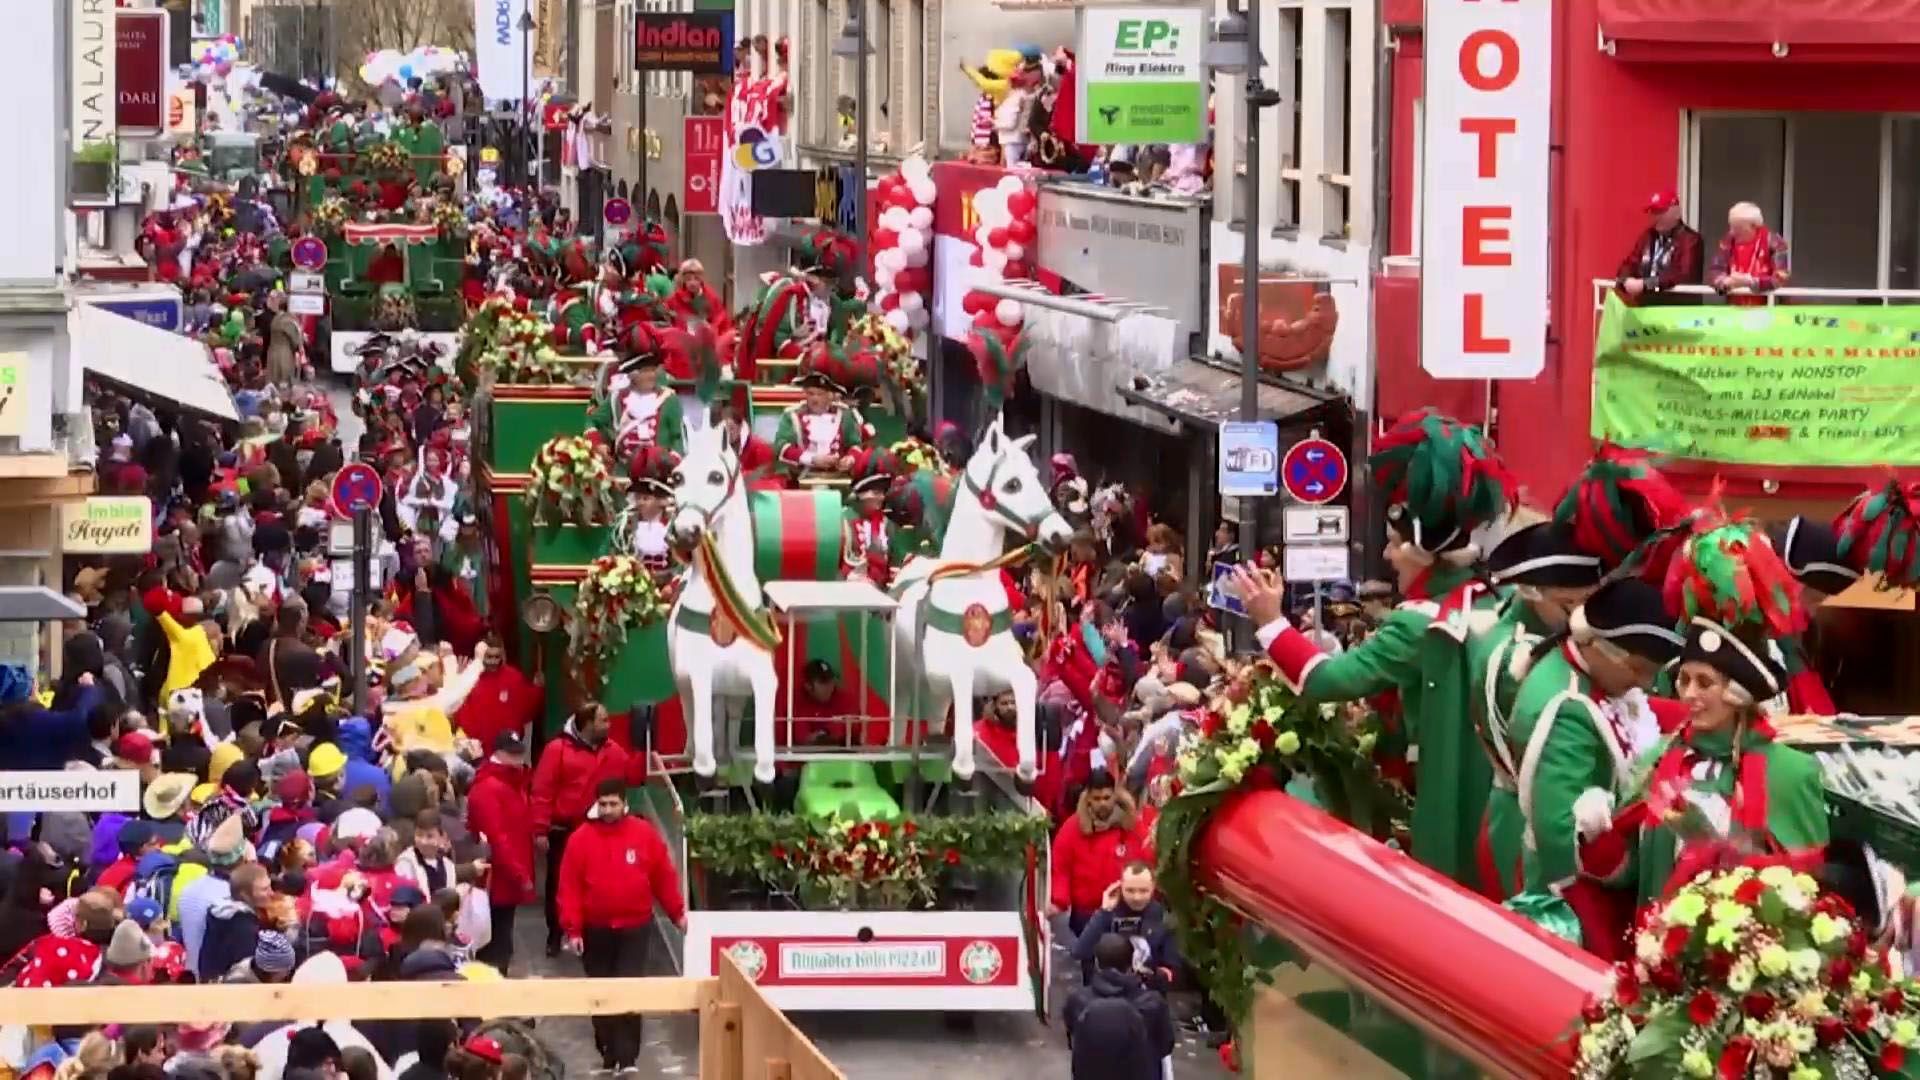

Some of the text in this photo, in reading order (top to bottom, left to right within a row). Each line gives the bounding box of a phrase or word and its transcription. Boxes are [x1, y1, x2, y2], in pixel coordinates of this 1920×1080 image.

[1114, 19, 1180, 50] EP:
[1459, 0, 1519, 354] OTEL
[1791, 365, 1868, 379] NONSTOP
[1818, 407, 1871, 422] PARTY
